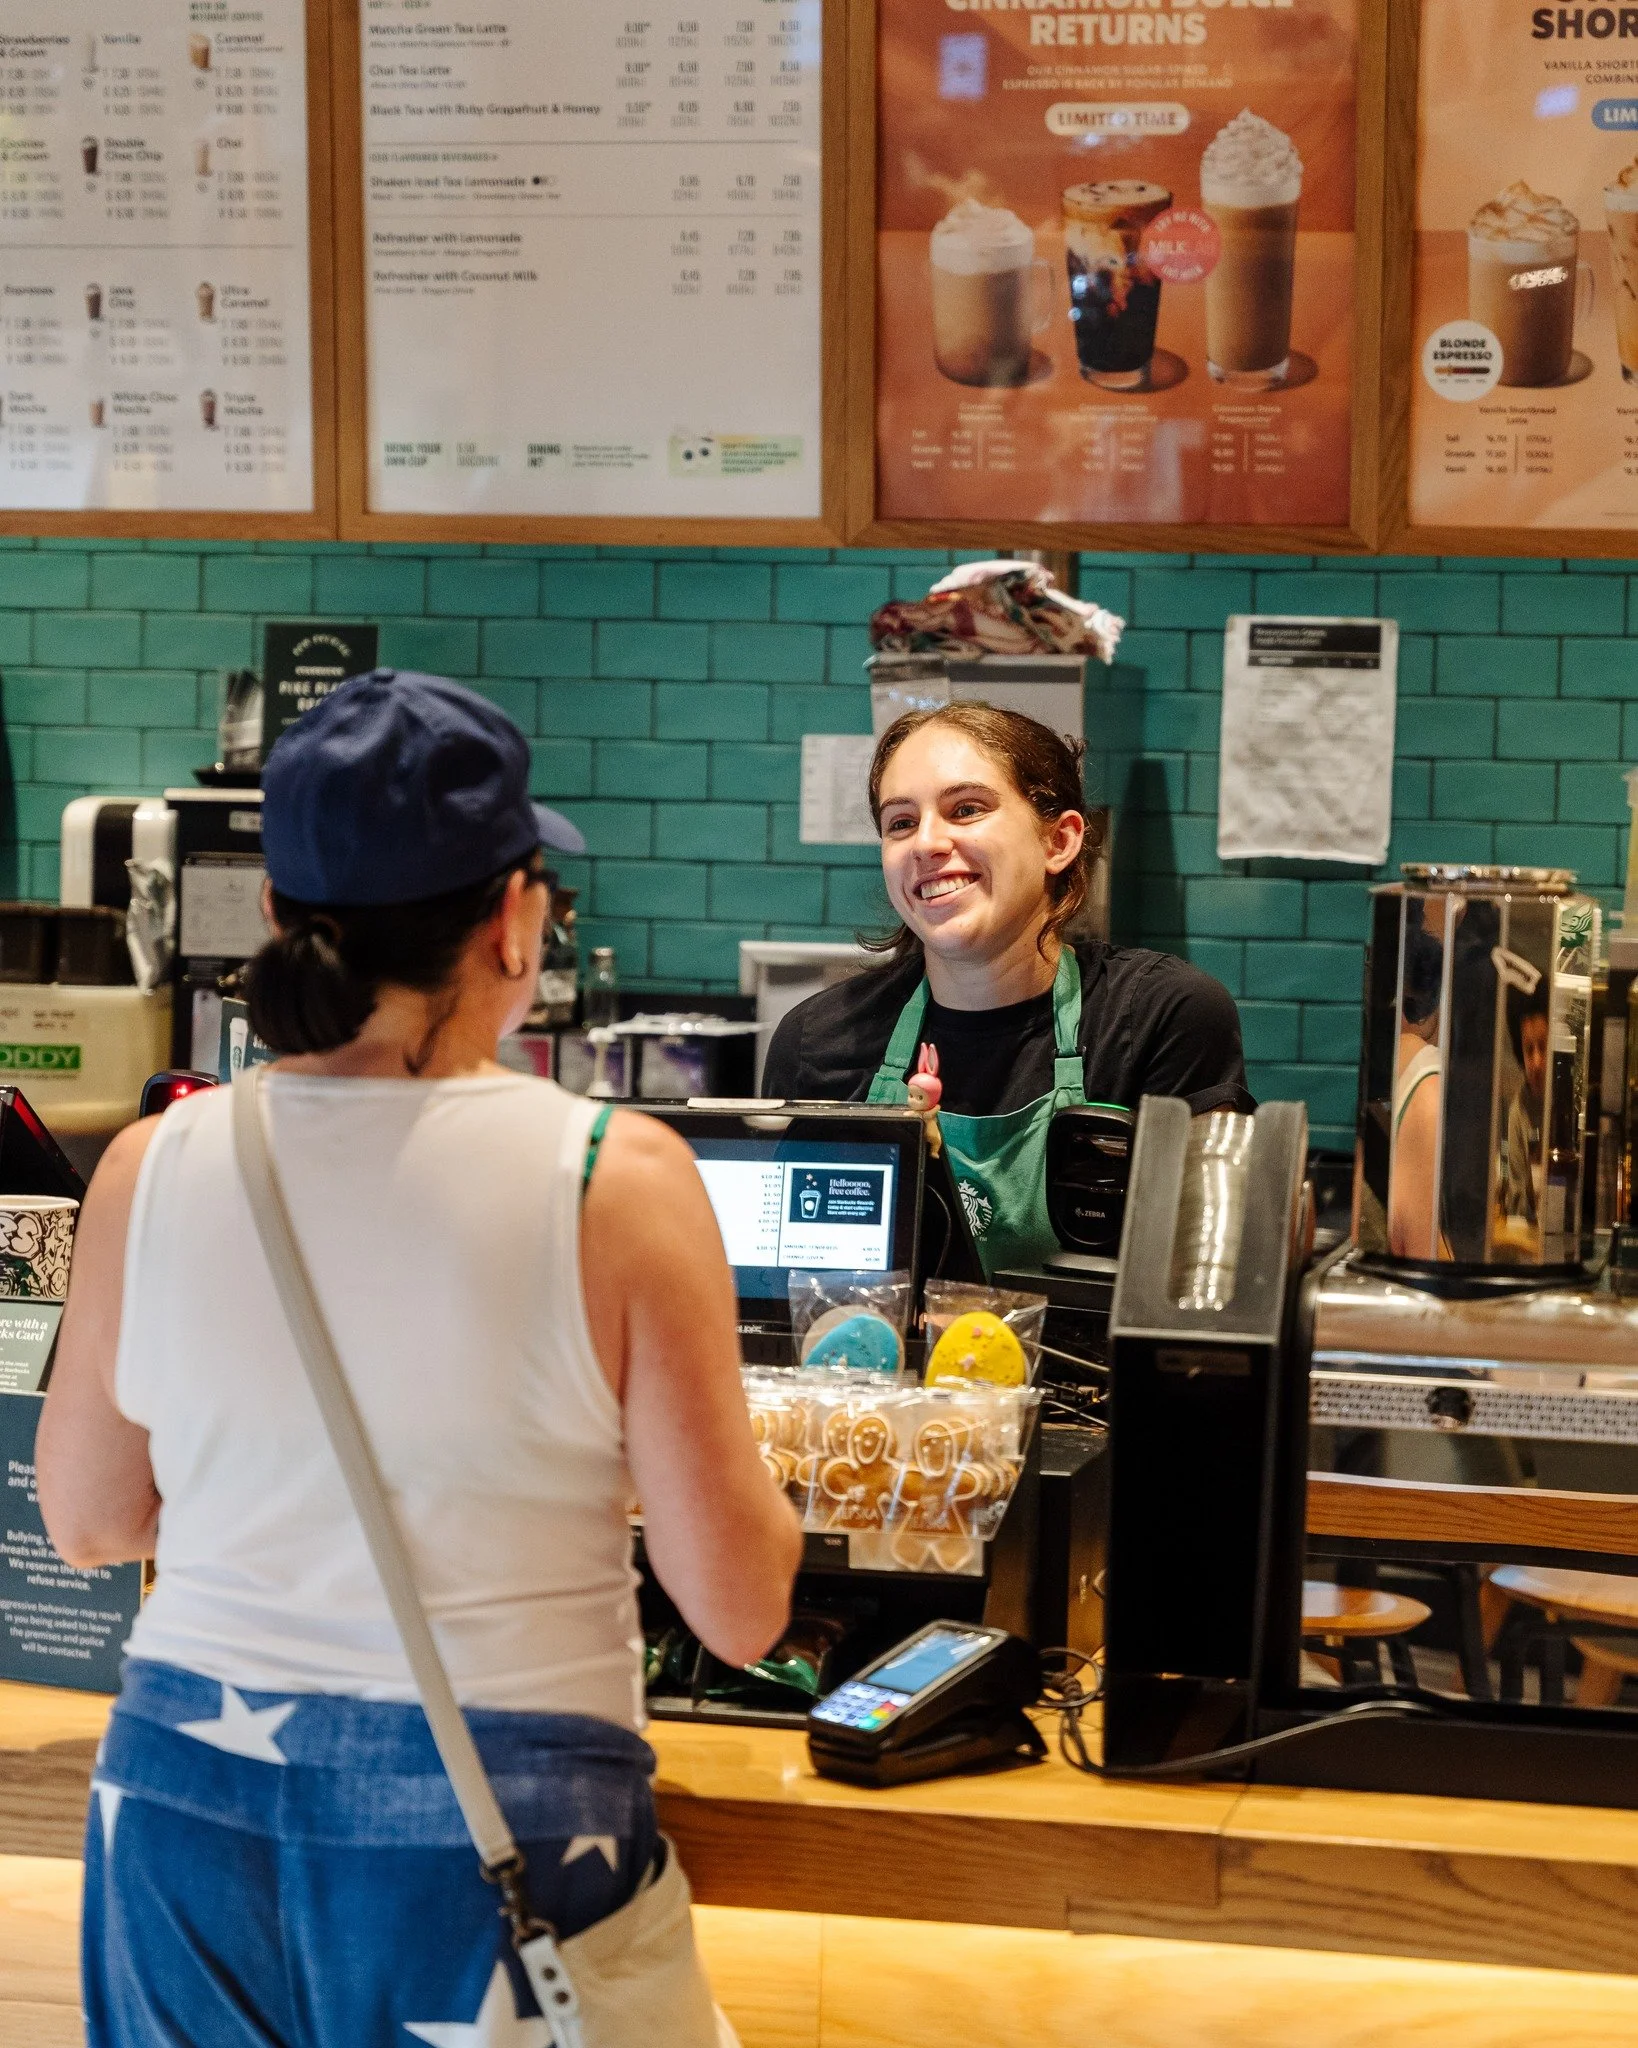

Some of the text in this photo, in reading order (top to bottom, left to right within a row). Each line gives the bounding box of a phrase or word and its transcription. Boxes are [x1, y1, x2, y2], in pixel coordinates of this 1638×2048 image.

[415, 24, 450, 35] Green
[454, 23, 474, 34] Tea
[476, 23, 507, 34] Latte
[1029, 13, 1208, 46] RETURNS
[399, 64, 417, 75] Tea
[421, 64, 450, 75] Latte
[1544, 60, 1638, 70] VANILLA SHORT
[1585, 74, 1638, 84] COMBIN
[370, 103, 601, 116] Black Tea with Ruby Grapefruit & Honey
[1603, 106, 1638, 123] LIM
[1057, 112, 1177, 127] LIMITED TIME
[370, 177, 411, 187] Shaken
[443, 176, 461, 187] Tea
[464, 177, 526, 187] Lemonade
[372, 232, 521, 243] Refresher with Lemonade
[373, 270, 538, 281] Refresher with Coconut Milk
[1440, 338, 1486, 348] BLONDE
[1433, 350, 1492, 360] ESPRESSO
[829, 1187, 870, 1196] free coffee.
[1085, 1210, 1105, 1219] ZEBRA
[15, 1317, 39, 1330] with
[40, 1321, 48, 1331] a
[0, 1328, 45, 1341] ks Card
[8, 1460, 35, 1475] Pleas
[8, 1476, 28, 1488] and
[7, 1529, 46, 1546] Bullying,
[0, 1542, 60, 1560] hreats will no
[9, 1557, 112, 1581] We reserve the right to
[27, 1574, 91, 1592] refuse service.
[38, 1602, 78, 1617] behaviour
[79, 1609, 98, 1621] may
[98, 1610, 121, 1622] result
[4, 1612, 111, 1635] in you being asked to leave
[9, 1626, 105, 1648] the premises and police
[21, 1641, 91, 1660] will be contacted.
